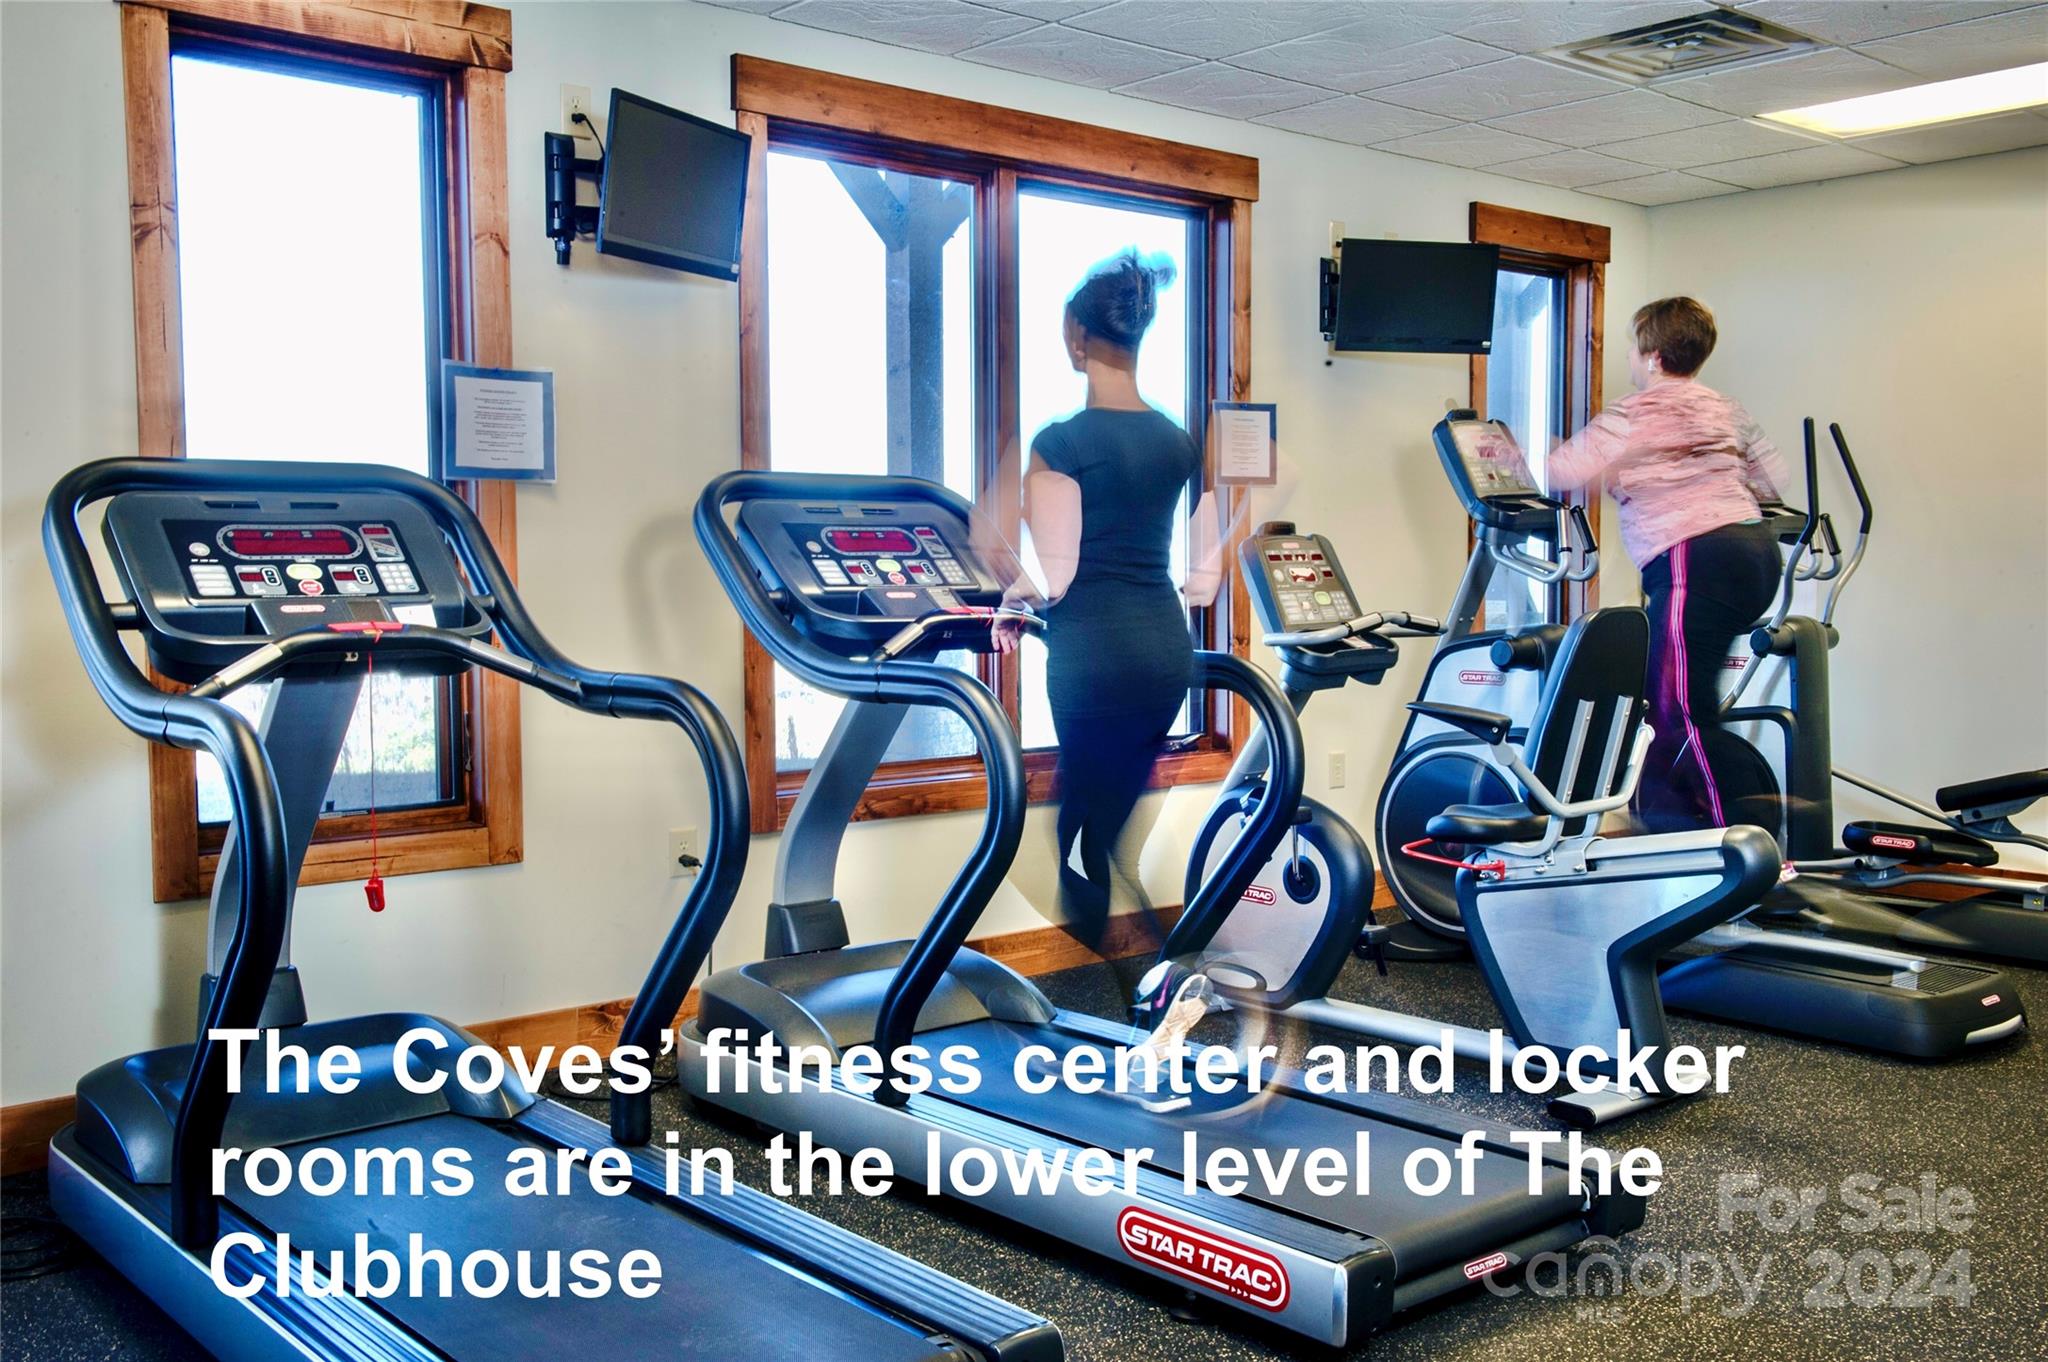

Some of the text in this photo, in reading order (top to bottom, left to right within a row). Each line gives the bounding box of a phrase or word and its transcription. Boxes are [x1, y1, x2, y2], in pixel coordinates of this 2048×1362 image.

[1249, 889, 1272, 900] TRAC
[1127, 1224, 1273, 1292] STAR TRAC
[1467, 1256, 1504, 1275] STAR TRAC
